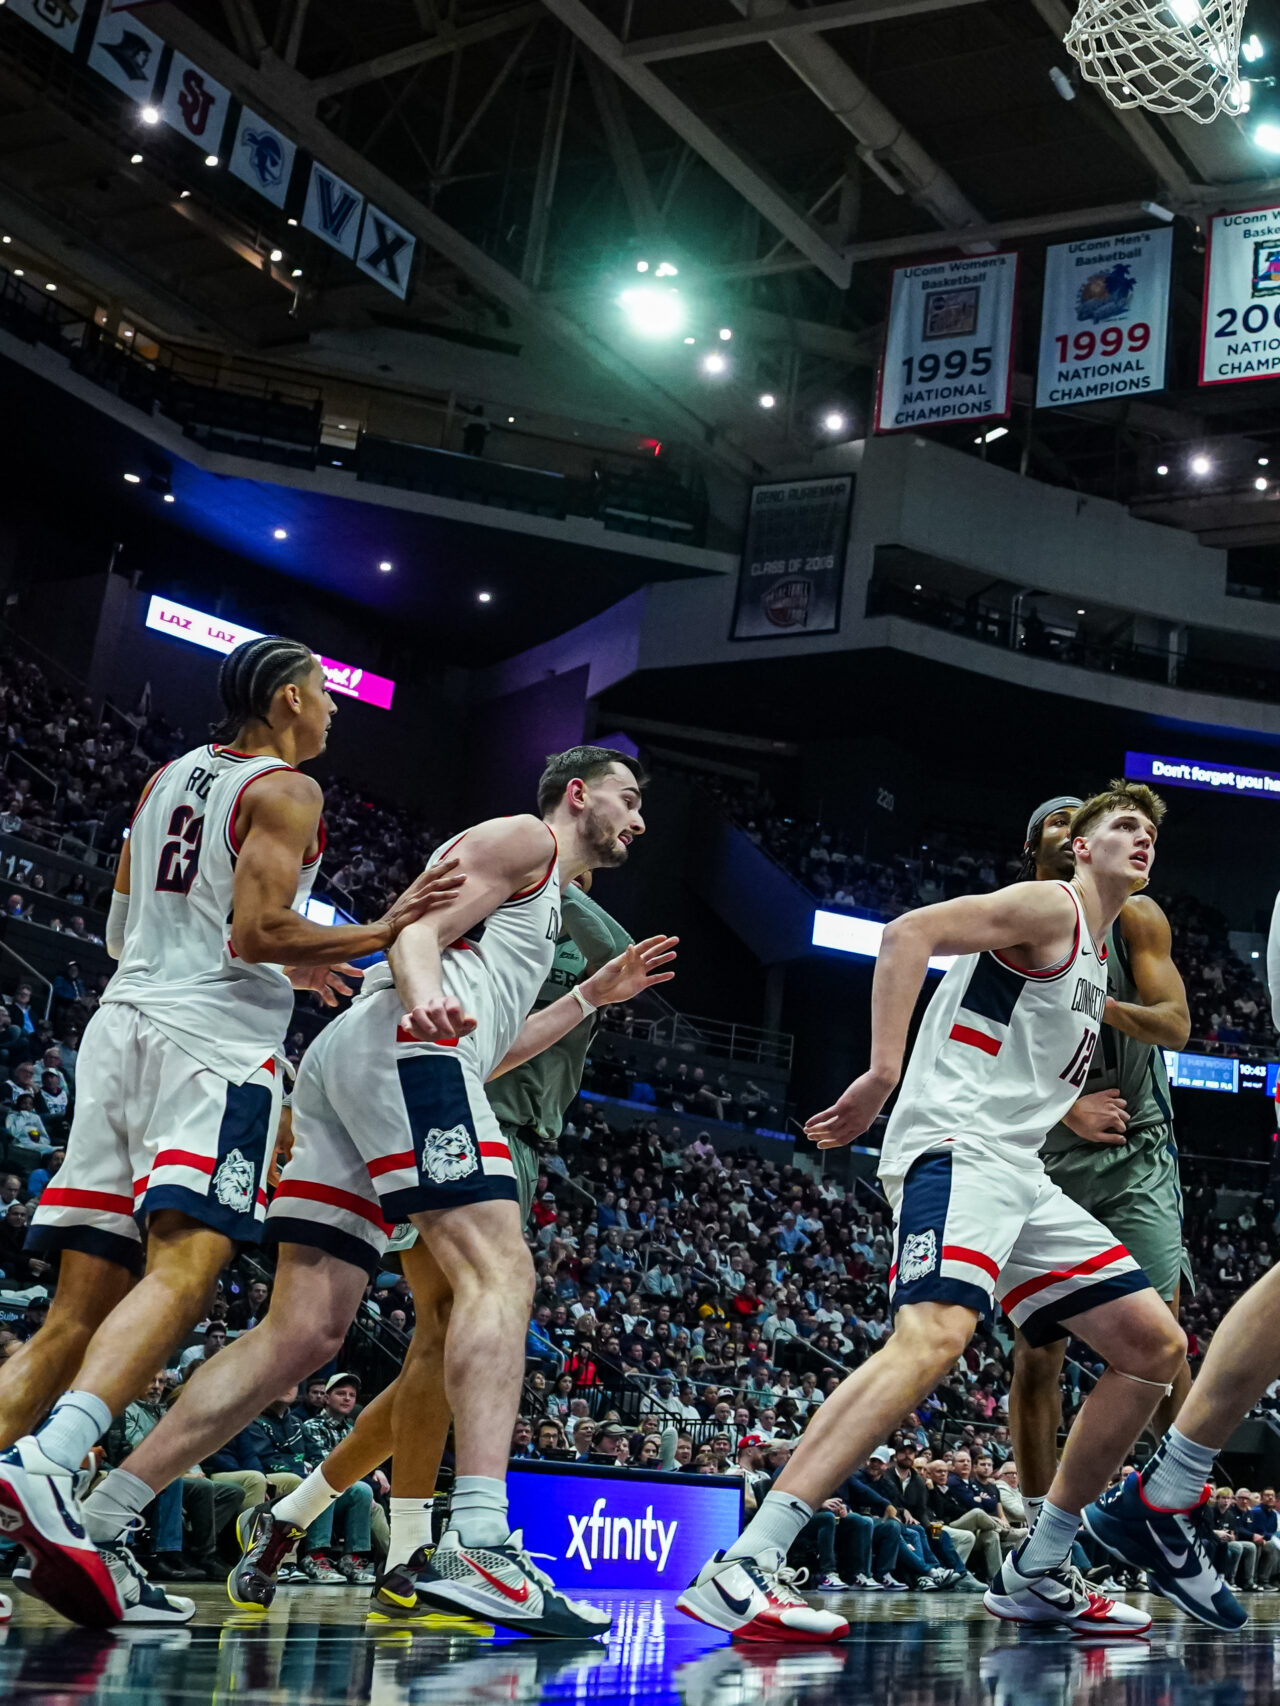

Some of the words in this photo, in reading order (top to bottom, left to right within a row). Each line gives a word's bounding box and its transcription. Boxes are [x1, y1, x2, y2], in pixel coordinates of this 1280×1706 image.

[1223, 213, 1268, 228] UConn
[364, 213, 410, 288] X
[1068, 240, 1111, 254] UConn
[1115, 232, 1152, 246] Men's
[904, 266, 945, 279] UConn
[950, 256, 1007, 272] Women's
[1075, 248, 1142, 267] Basketball
[921, 272, 987, 291] Basketball
[1055, 322, 1151, 363] 1999
[902, 346, 992, 386] 1995
[1057, 359, 1145, 383] NATIONAL
[903, 383, 987, 405] NATIONAL
[1049, 376, 1151, 402] CHAMPIONS
[895, 399, 992, 425] CHAMPIONS
[751, 560, 786, 576] CLASS
[788, 558, 802, 573] OF
[159, 610, 193, 630] LAZ
[207, 627, 236, 644] LAZ
[1152, 760, 1191, 779] Don't
[1192, 766, 1235, 786] forget
[1236, 774, 1264, 789] you
[0, 852, 33, 878] 17
[1059, 1027, 1097, 1088] 12
[1240, 1064, 1267, 1077] 10:43
[565, 1498, 678, 1572] xfinity
